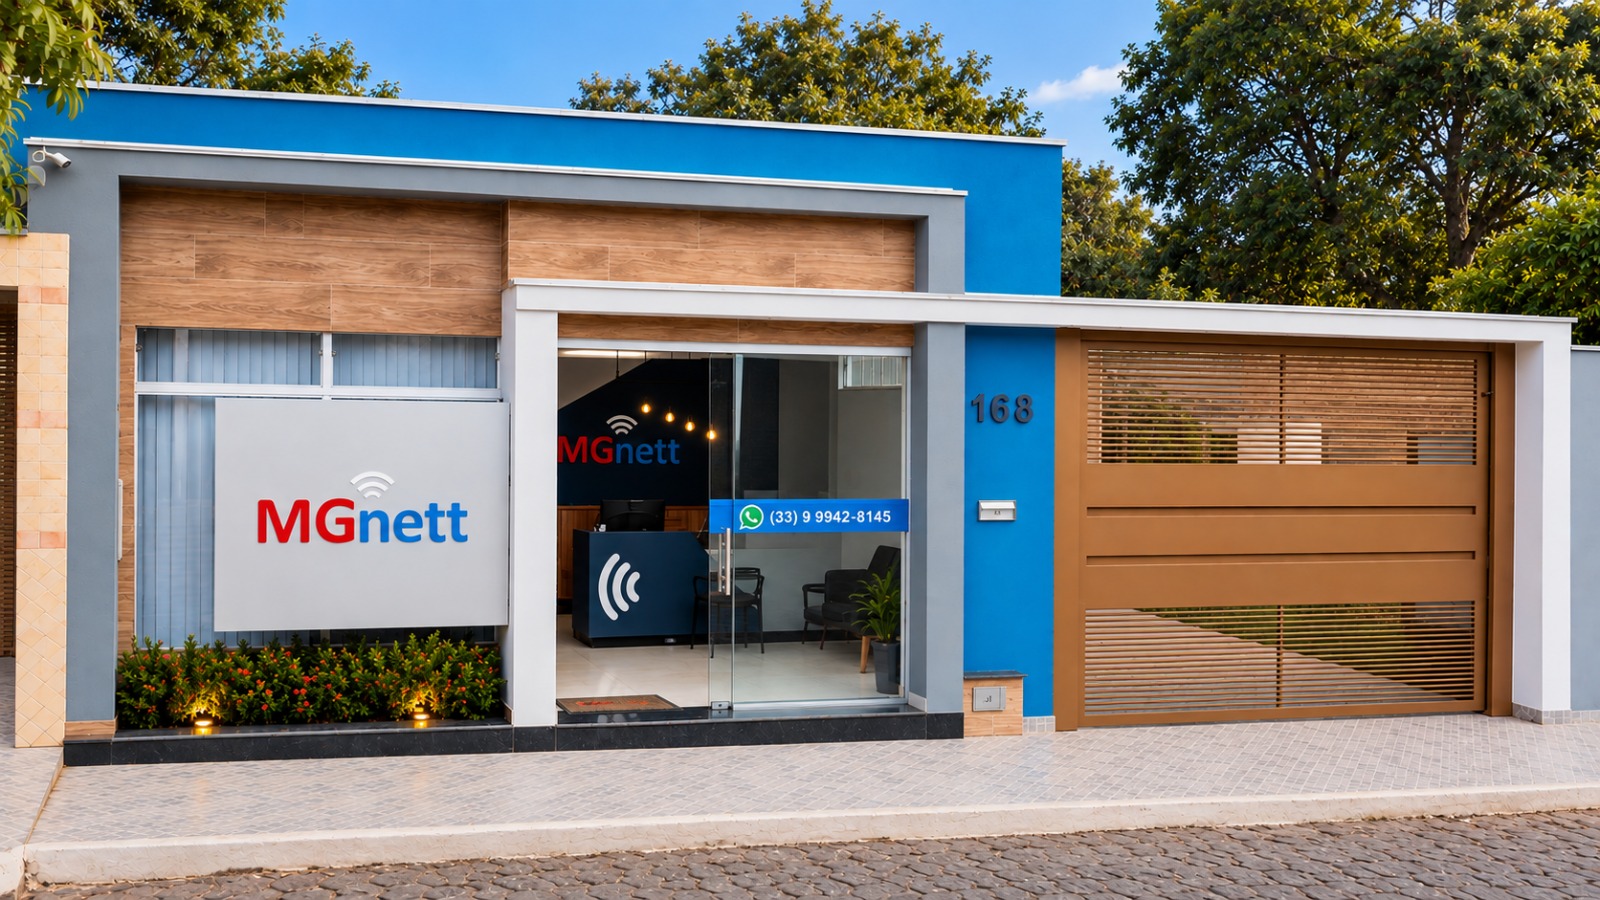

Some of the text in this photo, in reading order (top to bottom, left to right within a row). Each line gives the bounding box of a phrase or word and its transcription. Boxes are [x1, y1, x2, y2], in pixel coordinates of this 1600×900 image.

[971, 394, 1034, 424] 168
[557, 435, 681, 465] MGnett
[257, 498, 468, 543] MGnett
[769, 510, 891, 526] (33) 9 9942-8145
